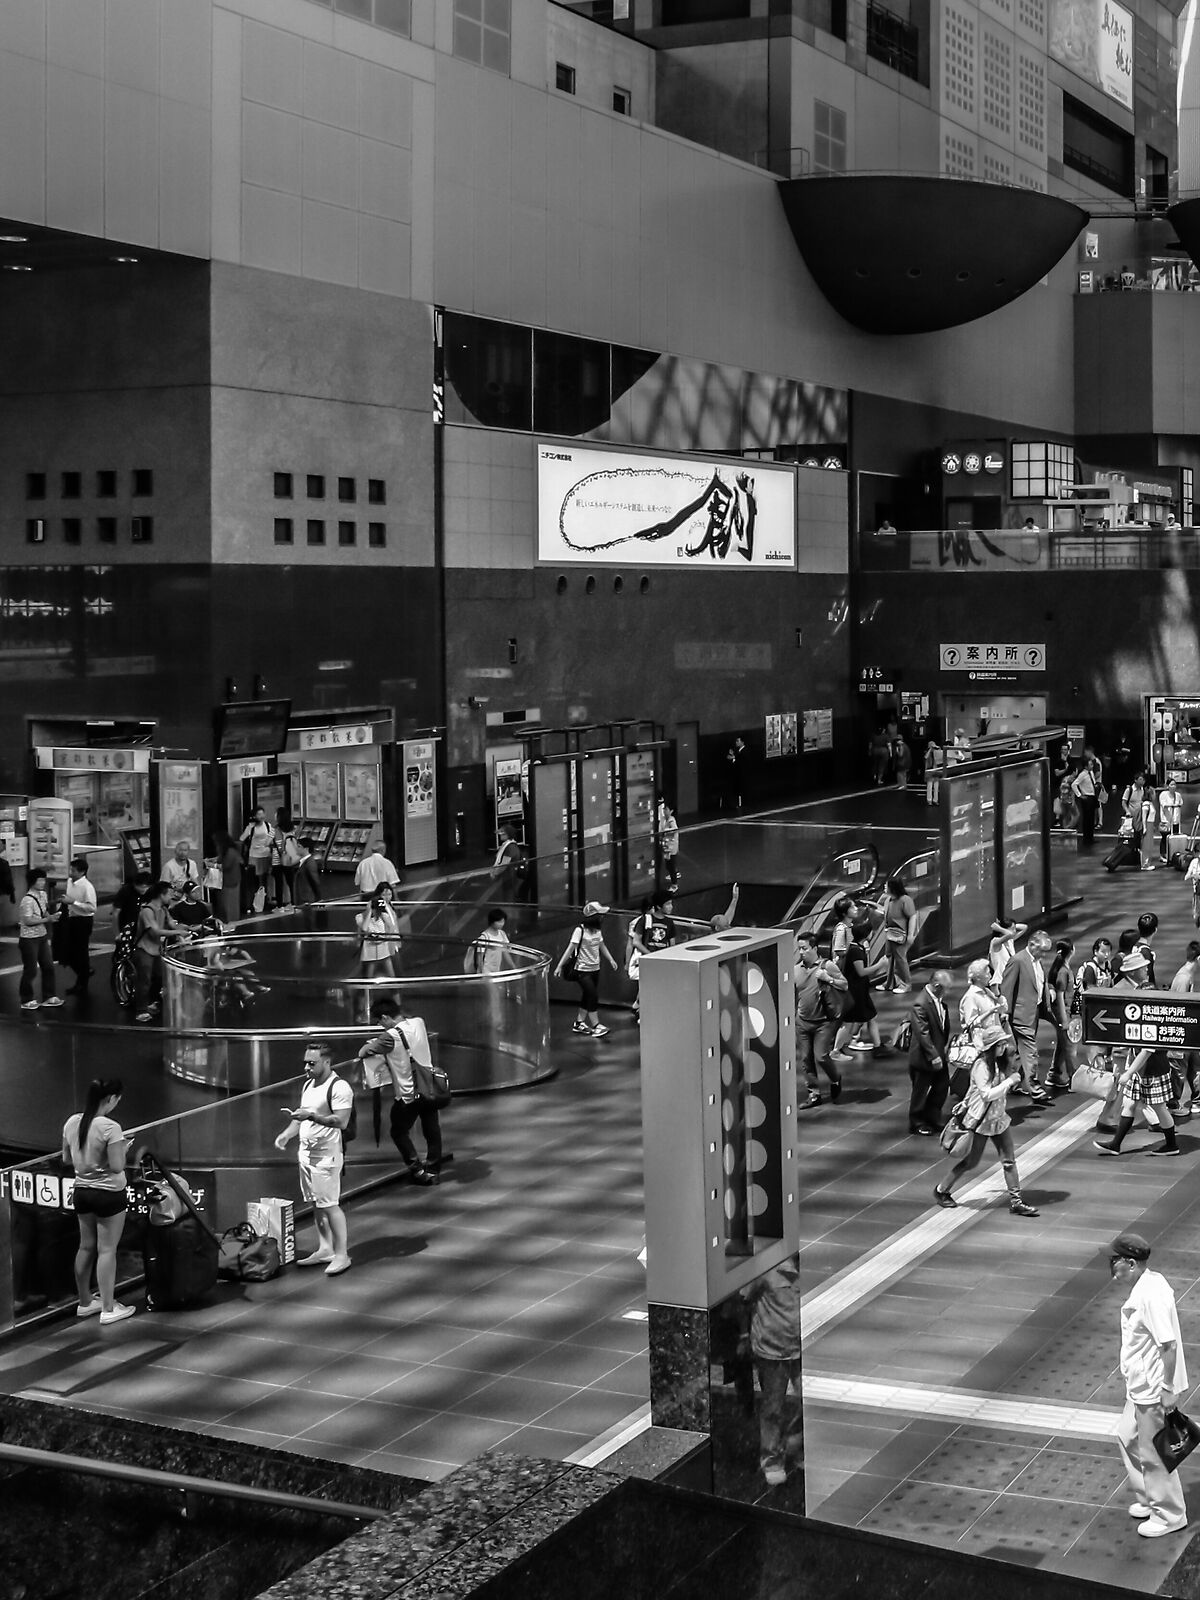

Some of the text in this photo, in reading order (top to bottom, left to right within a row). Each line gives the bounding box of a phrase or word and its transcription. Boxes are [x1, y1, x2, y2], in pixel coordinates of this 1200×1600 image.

[765, 551, 792, 561] nichicon
[967, 646, 1018, 660] 案内所
[1142, 1005, 1186, 1017] 鉄道案内所
[1142, 1014, 1198, 1024] Railway Information
[1158, 1025, 1185, 1037] お手洗
[1158, 1035, 1184, 1044] Lavatory
[284, 1204, 295, 1264] NIKE.COM
